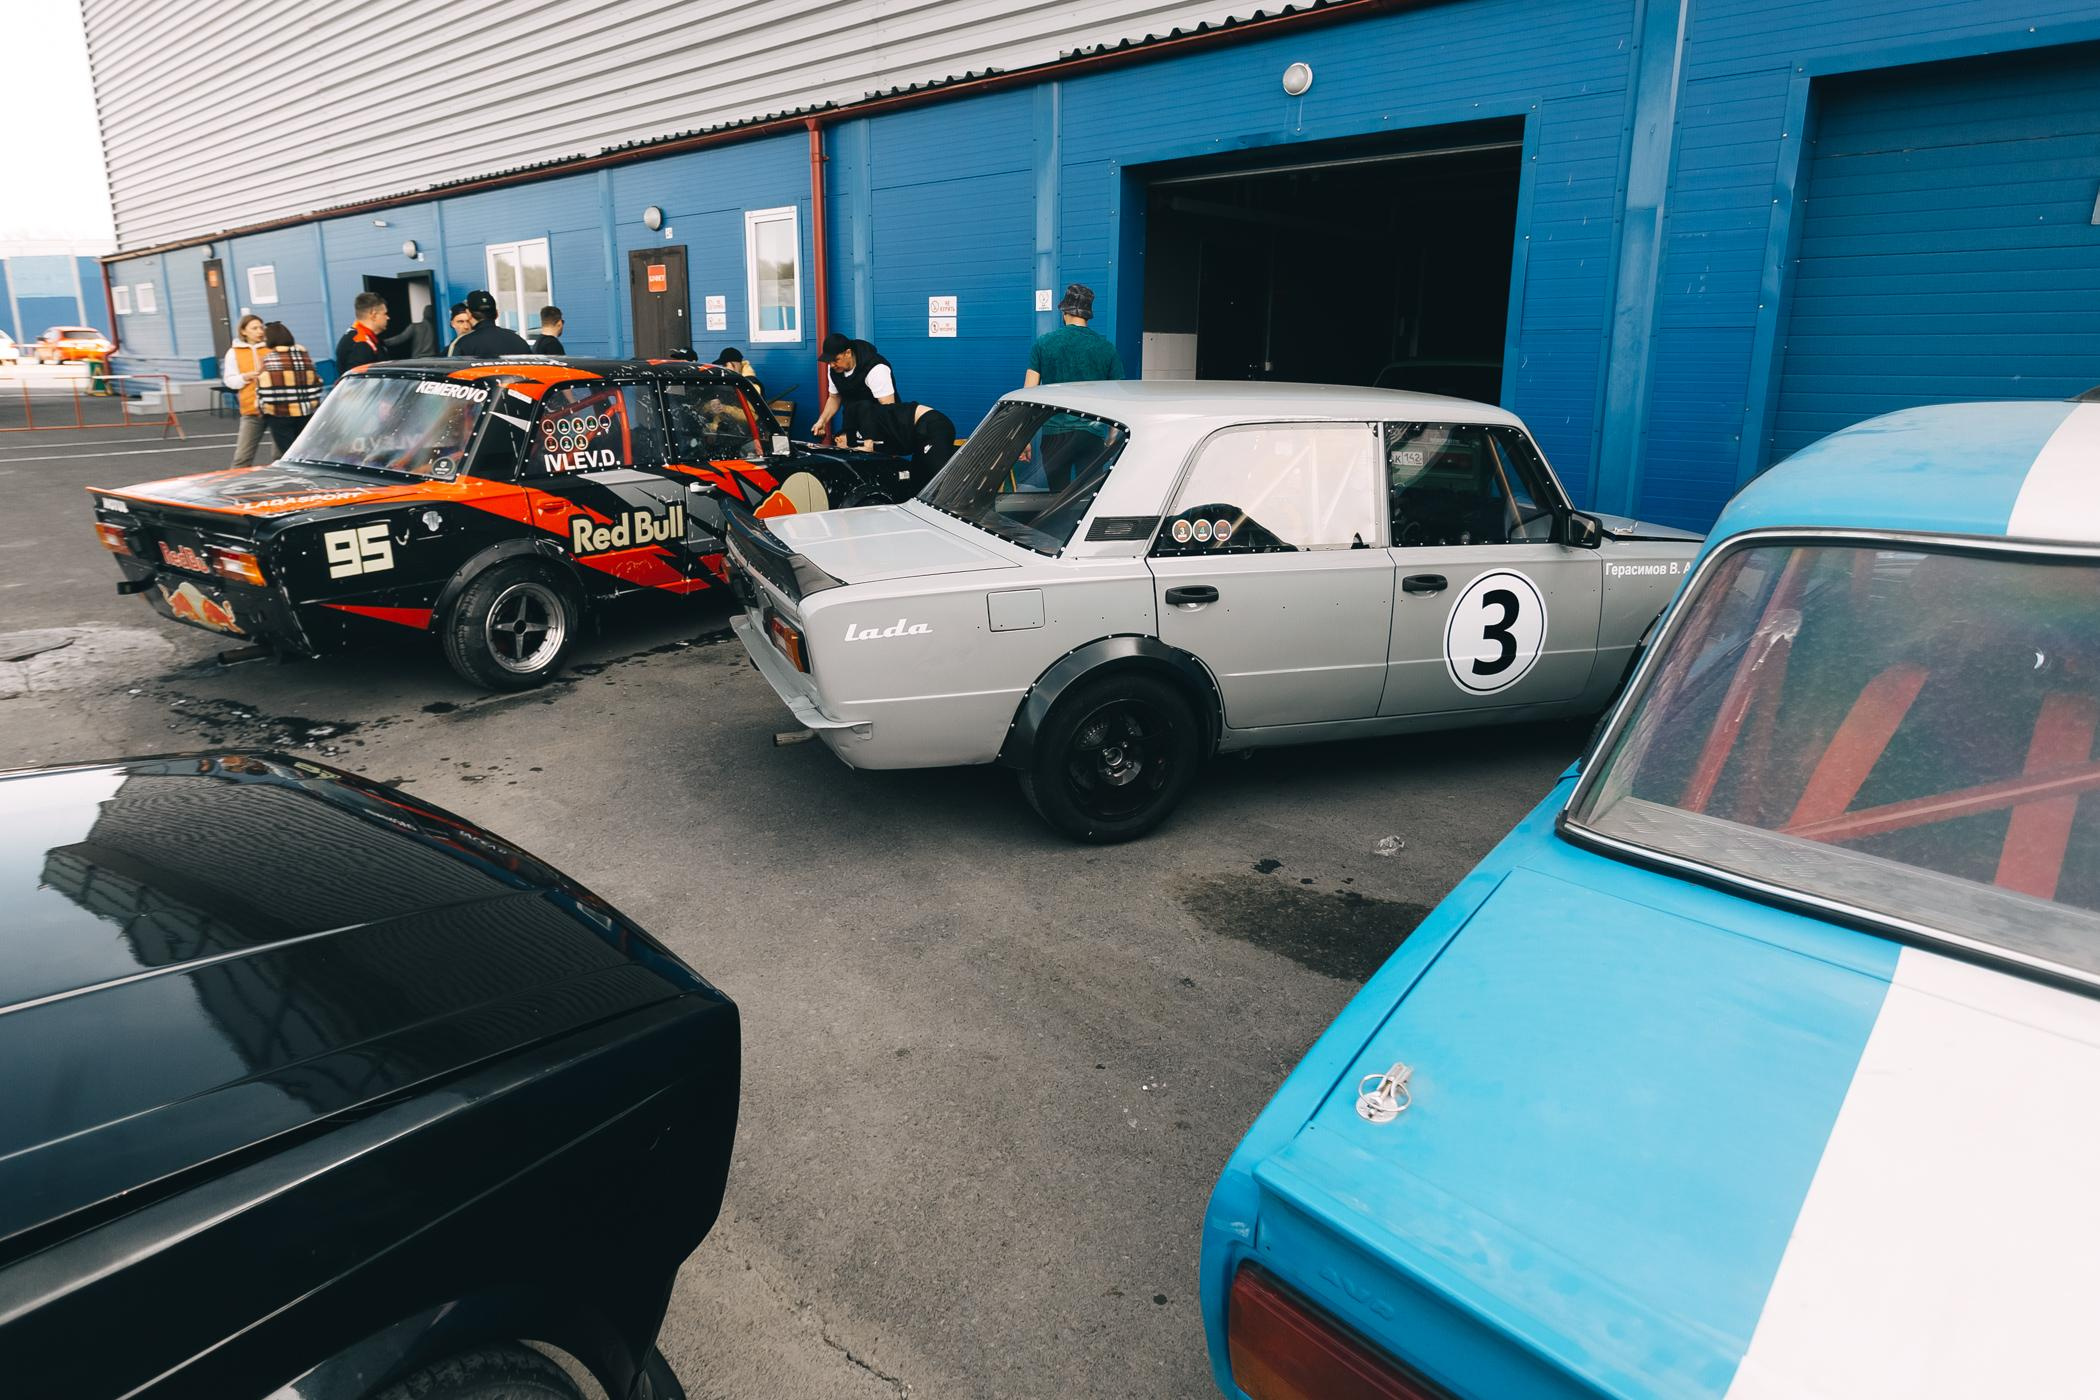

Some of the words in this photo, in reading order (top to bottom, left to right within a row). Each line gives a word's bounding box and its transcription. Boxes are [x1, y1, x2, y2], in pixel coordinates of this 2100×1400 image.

[415, 380, 489, 403] KEMEROVO
[243, 491, 362, 510] LADASPORT
[572, 512, 630, 554] Red
[634, 505, 684, 544] Bull
[324, 523, 395, 580] 95
[1605, 562, 1667, 579] Герасимов
[1669, 561, 1680, 575] В.
[1471, 589, 1520, 676] 3
